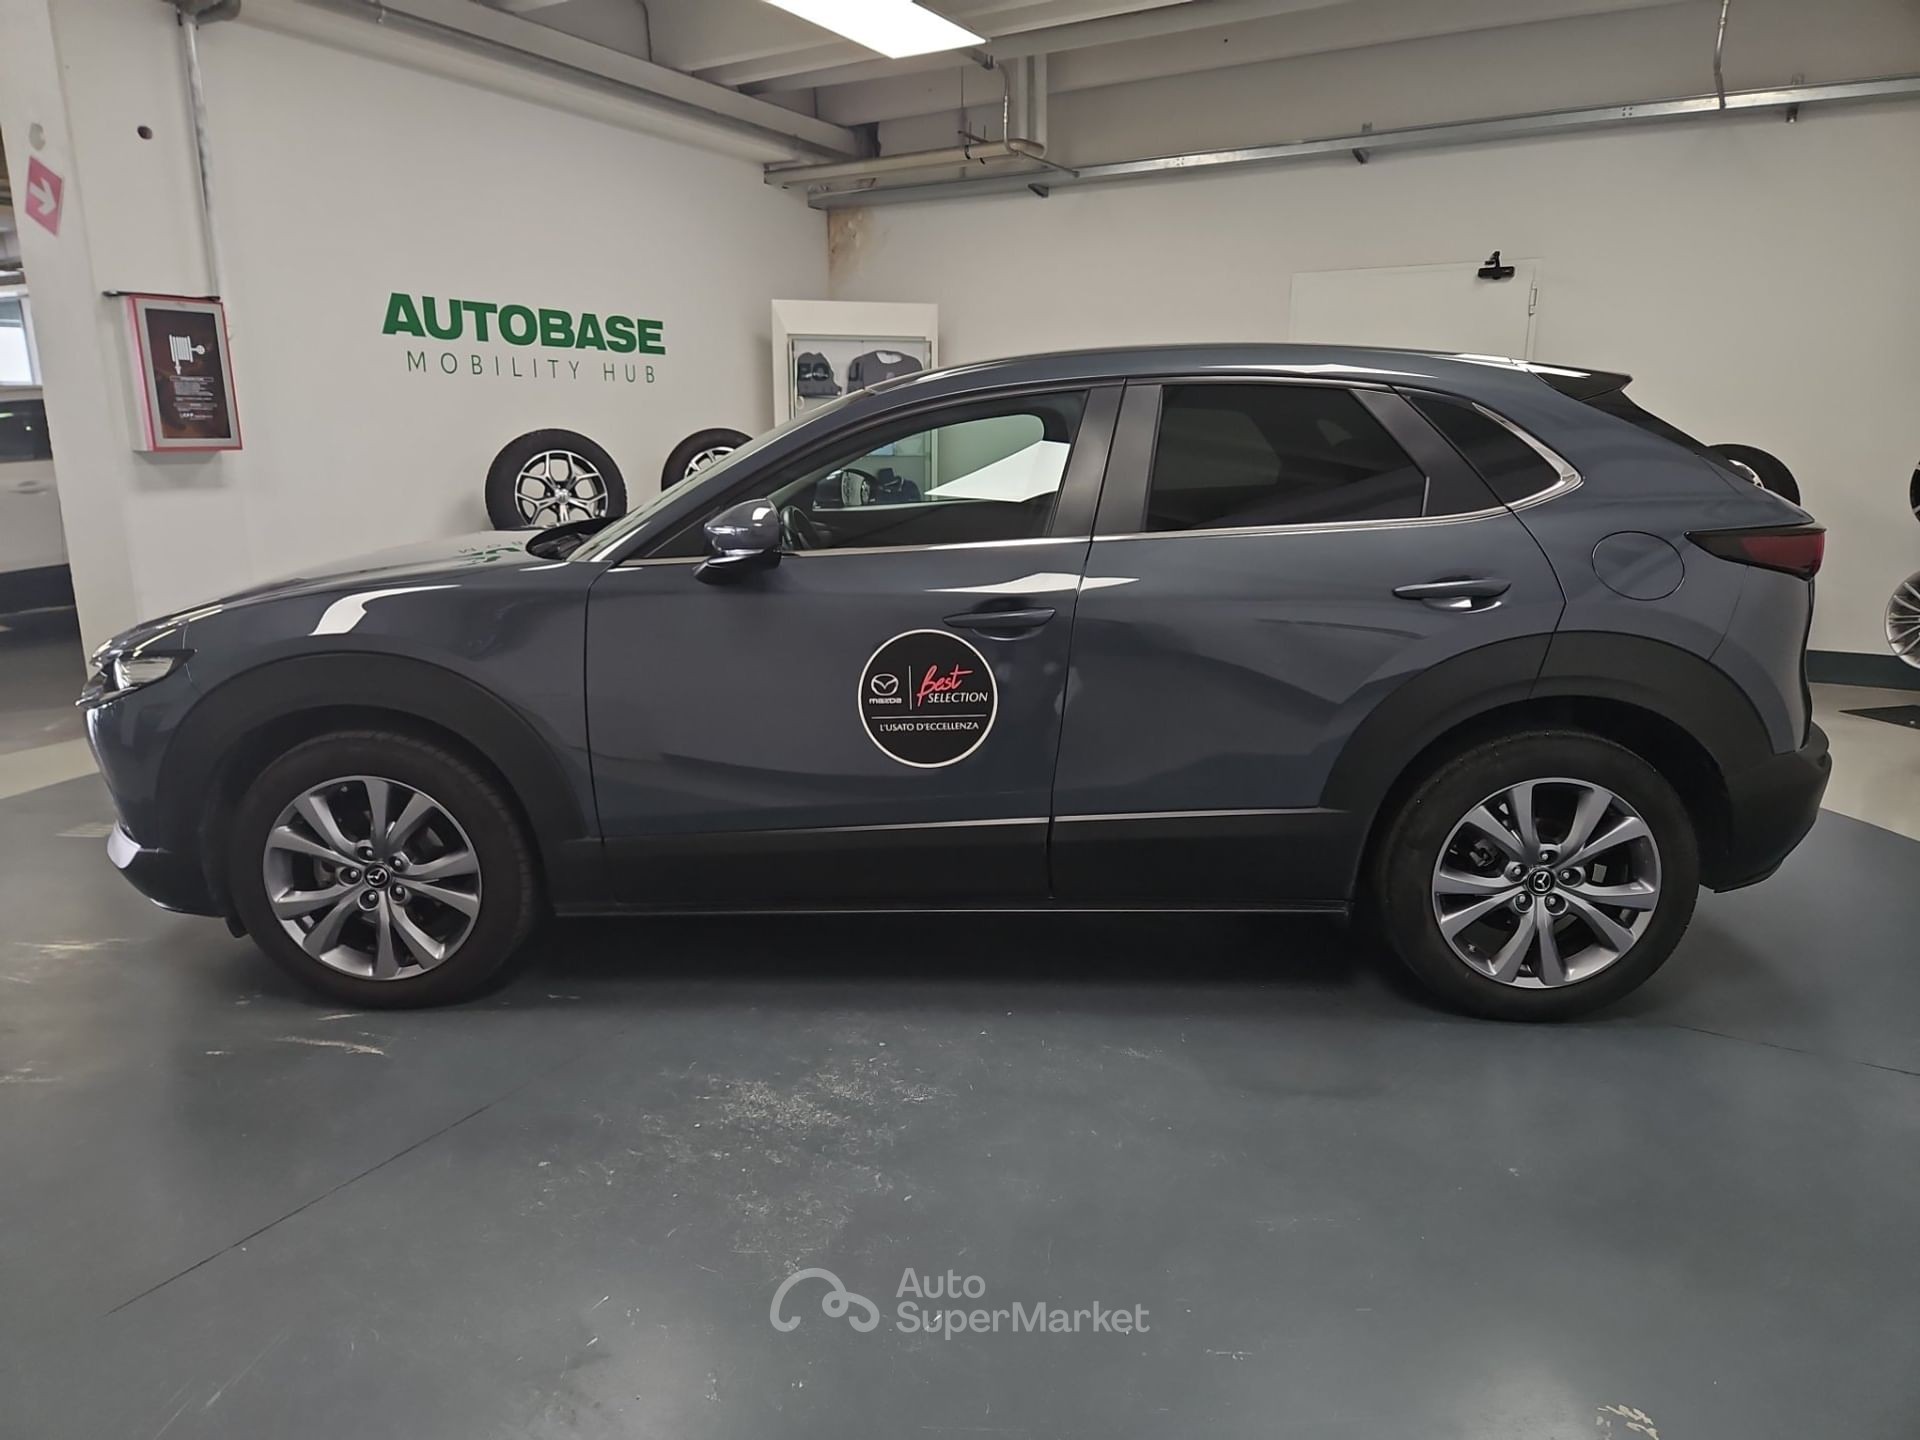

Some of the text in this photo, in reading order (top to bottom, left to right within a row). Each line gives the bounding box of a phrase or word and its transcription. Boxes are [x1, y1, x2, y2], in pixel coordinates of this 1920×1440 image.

[382, 292, 666, 355] AUTOBASE
[406, 351, 655, 383] MOBILITY HUB
[928, 691, 988, 703] SELECTION
[880, 721, 979, 732] L'USATO D'ECCELLENZA
